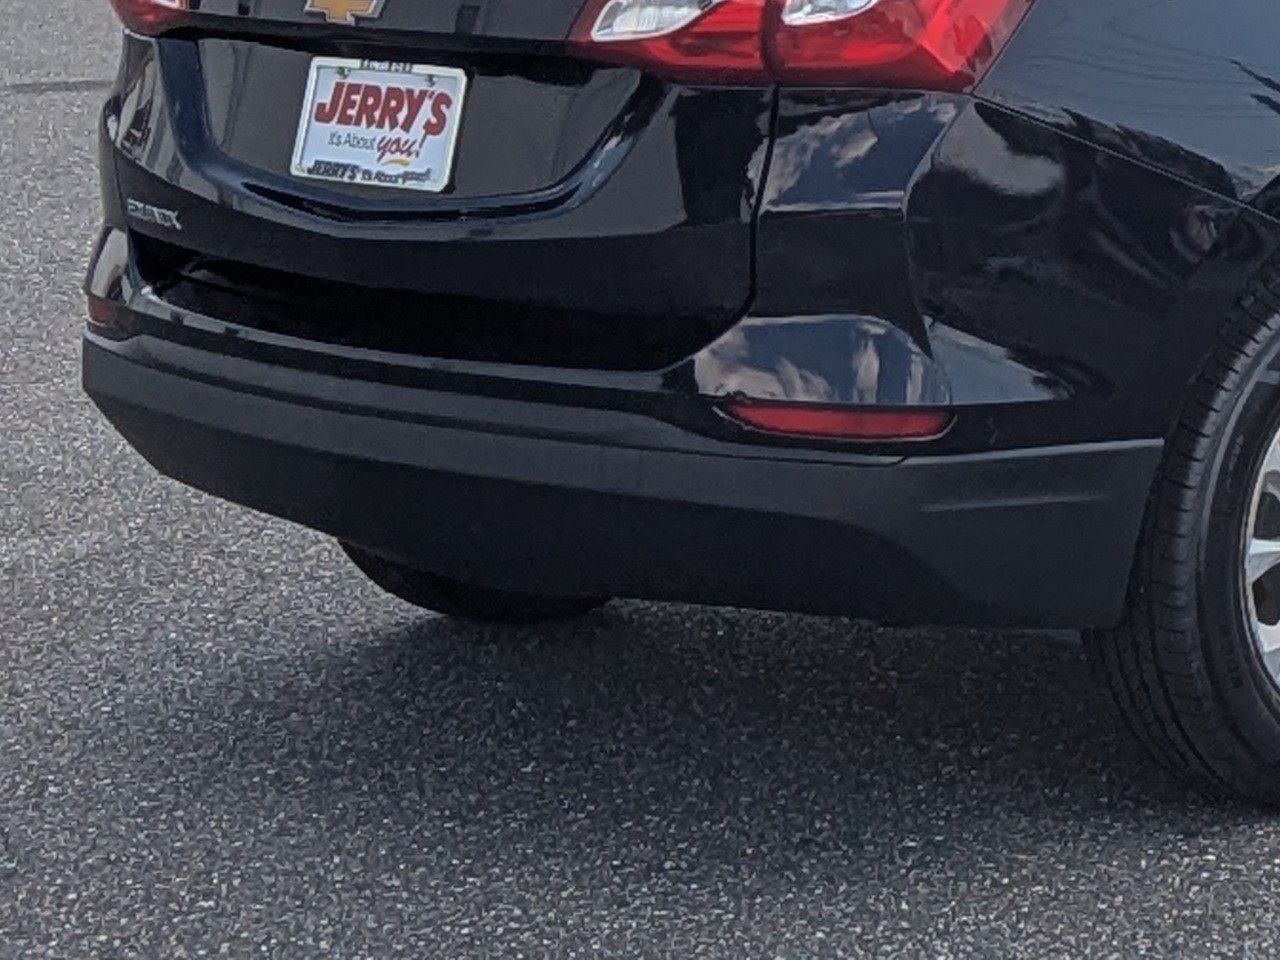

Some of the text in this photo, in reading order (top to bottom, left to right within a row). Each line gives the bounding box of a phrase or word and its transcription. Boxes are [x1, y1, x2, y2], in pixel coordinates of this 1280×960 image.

[314, 81, 453, 136] JERRY'S
[344, 132, 376, 151] About
[376, 133, 428, 163] you!
[307, 159, 360, 181] JERRY'S
